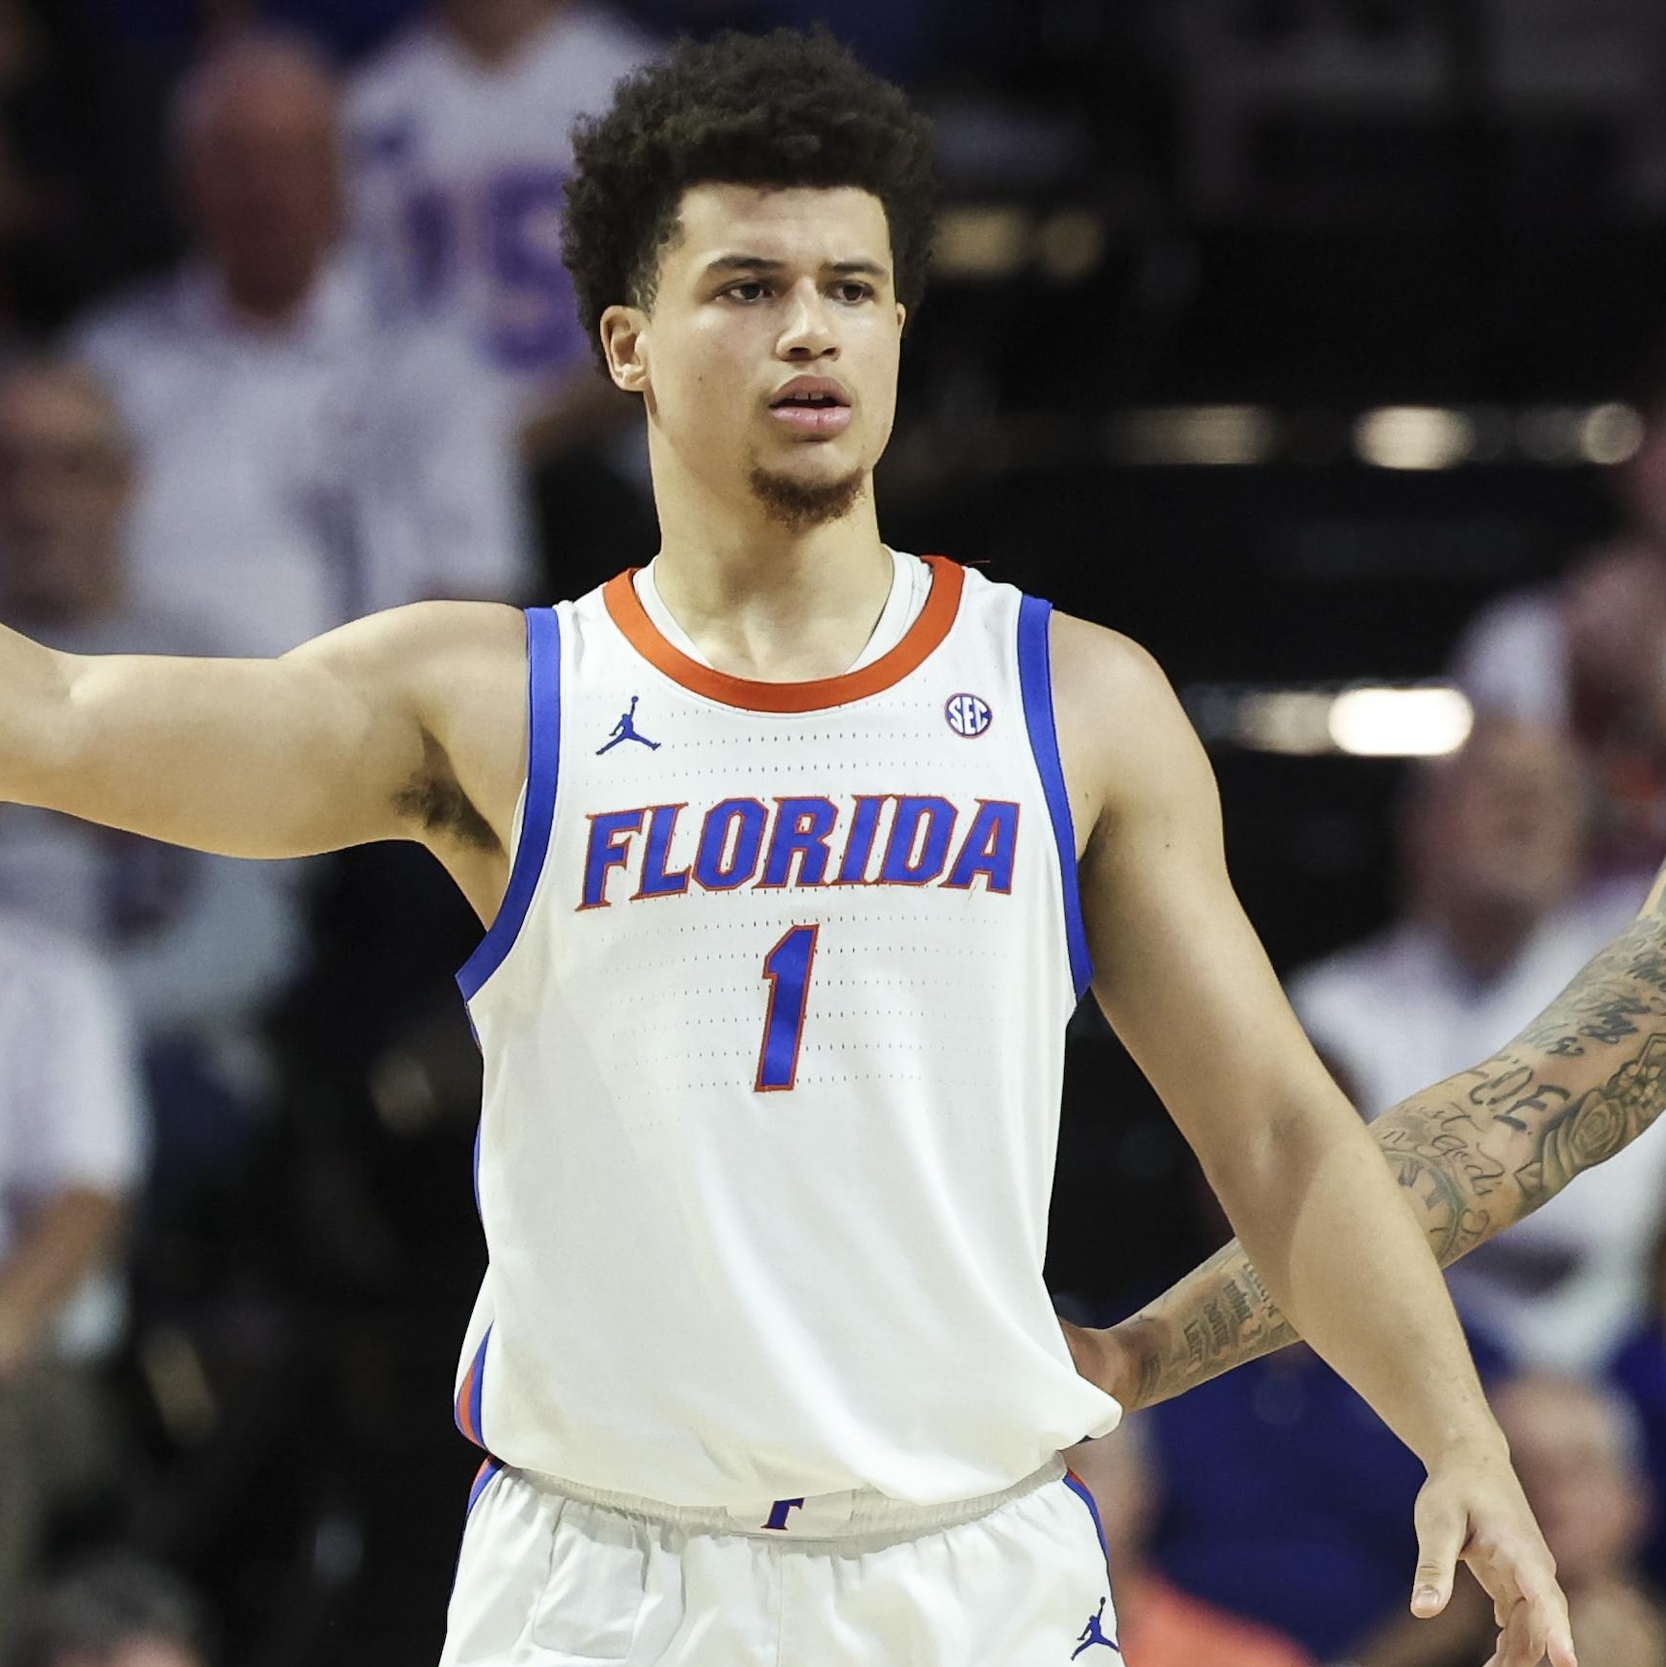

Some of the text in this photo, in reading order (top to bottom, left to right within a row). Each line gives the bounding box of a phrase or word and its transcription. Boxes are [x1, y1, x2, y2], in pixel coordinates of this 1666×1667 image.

[948, 696, 989, 735] SEC
[575, 794, 1021, 912] FLORIDA
[753, 923, 820, 1093] 1
